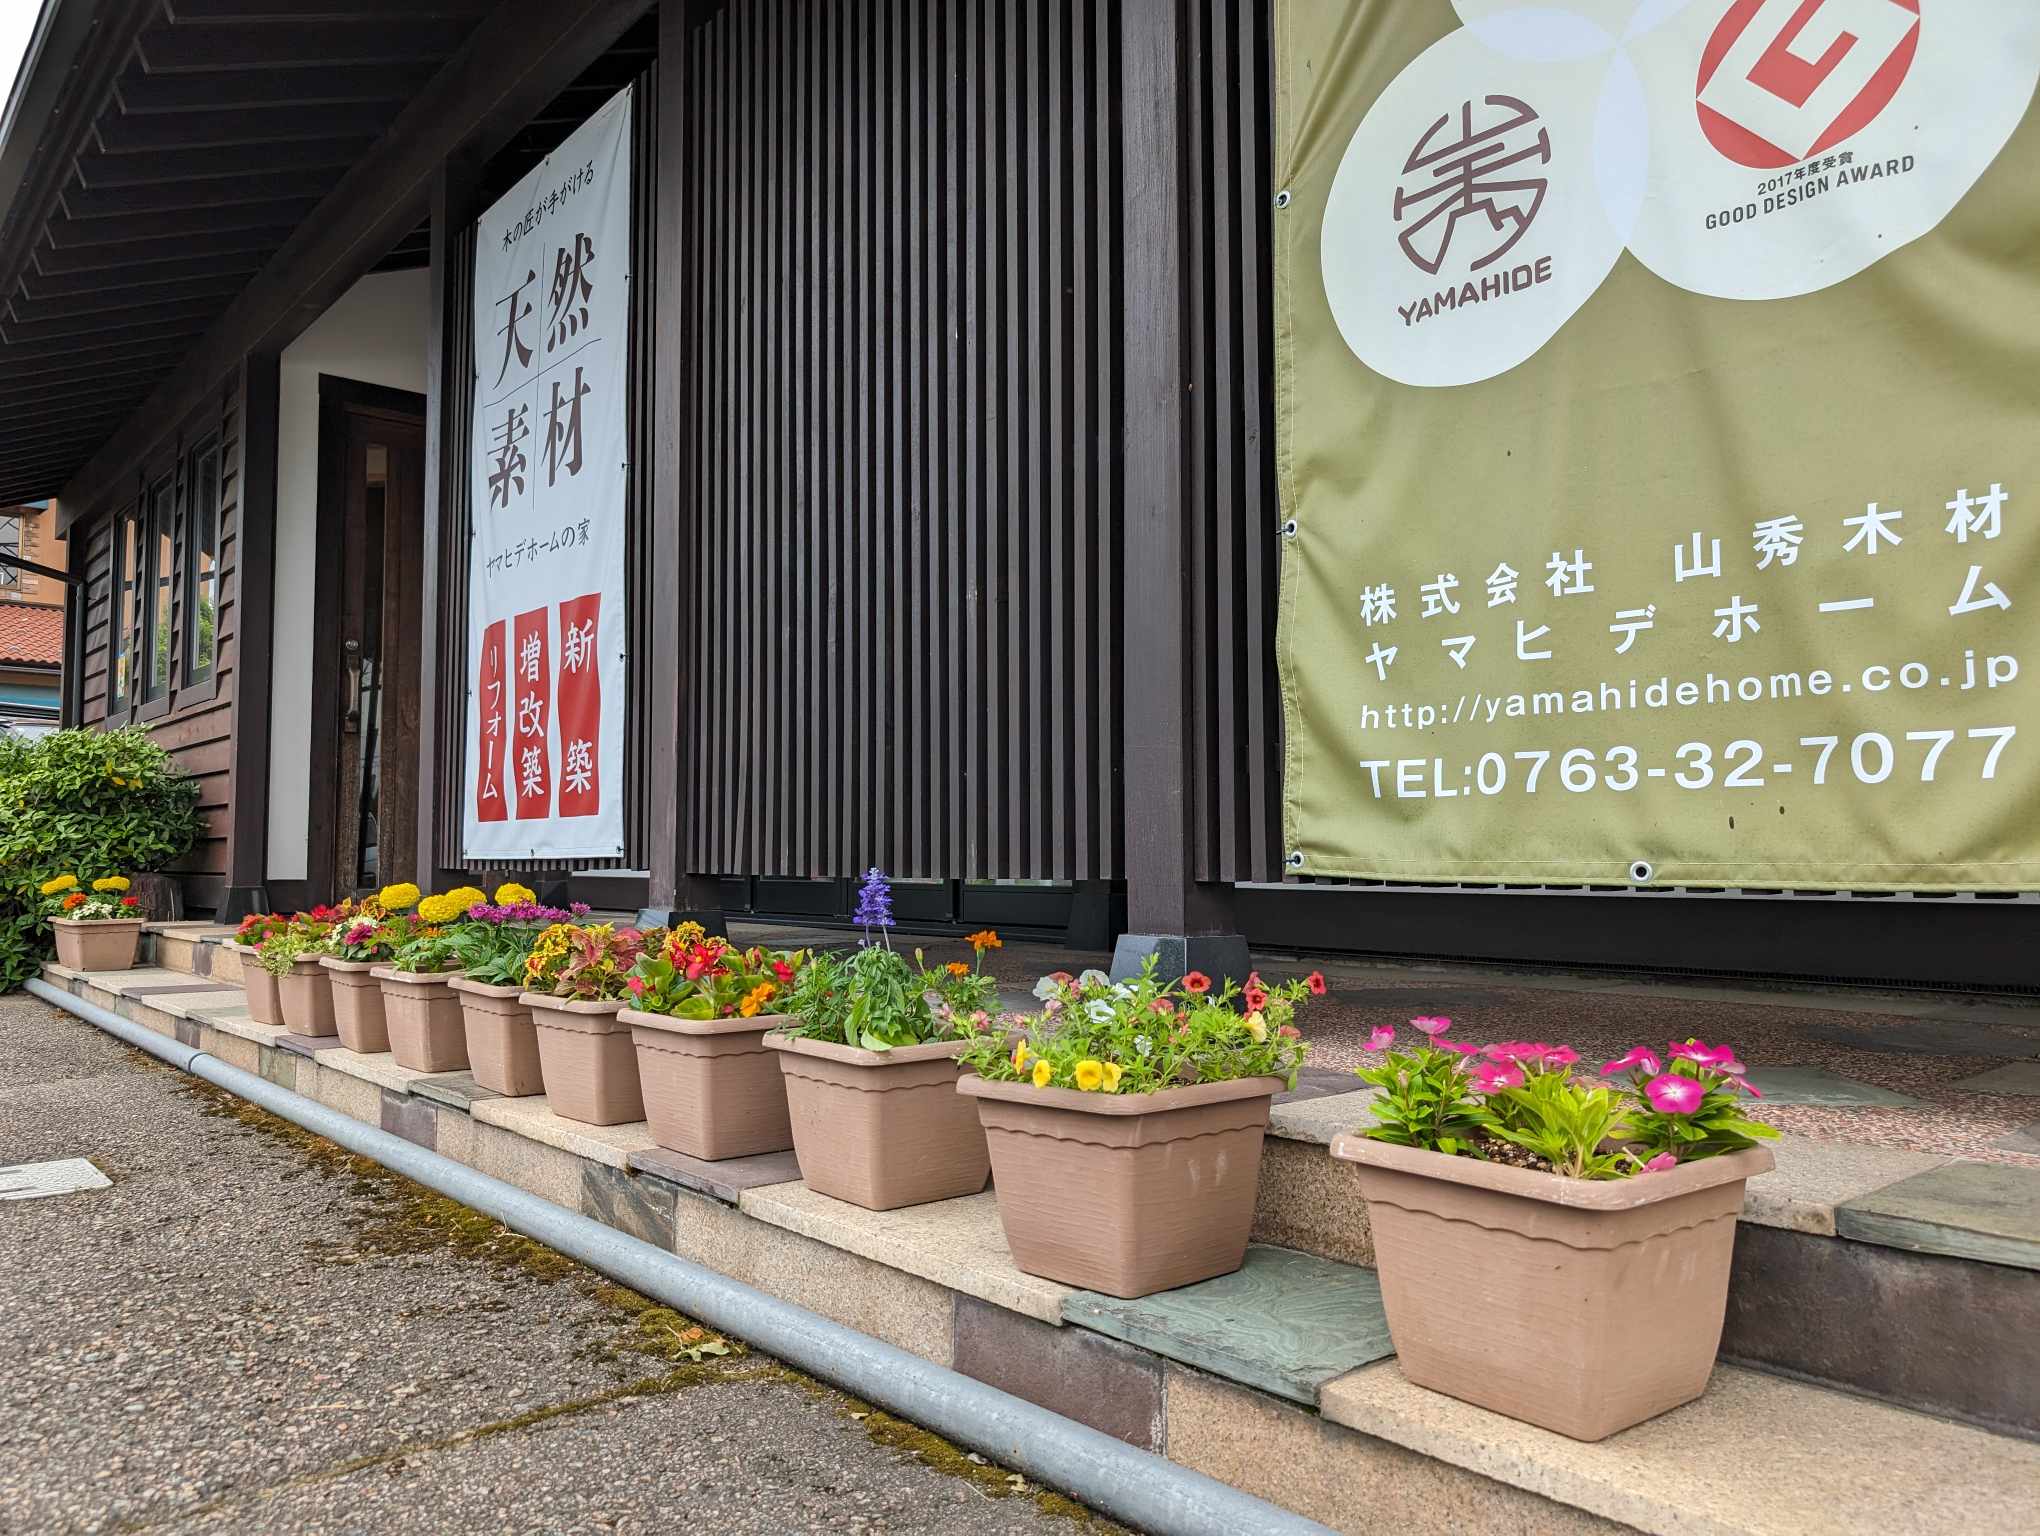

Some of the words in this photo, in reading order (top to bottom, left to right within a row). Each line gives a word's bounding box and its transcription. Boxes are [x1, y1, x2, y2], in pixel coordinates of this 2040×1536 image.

[502, 159, 594, 253] 木の匠が手がける
[1705, 203, 1757, 230] GOOD
[1763, 175, 1829, 214] DESIGN
[1836, 155, 1915, 188] AWARD
[1757, 151, 1855, 196] 2017年度受賞
[1397, 255, 1552, 327] YAMAHIDE
[486, 518, 591, 579] ヤマヒデホームの家
[1366, 565, 2012, 682] ヤマヒデホーム
[518, 630, 545, 799] 増改築
[562, 618, 594, 796] 新築
[1360, 649, 2020, 731] http://yamahidehome.co.jp
[1359, 725, 2018, 799] TEL:0763-32-7077
